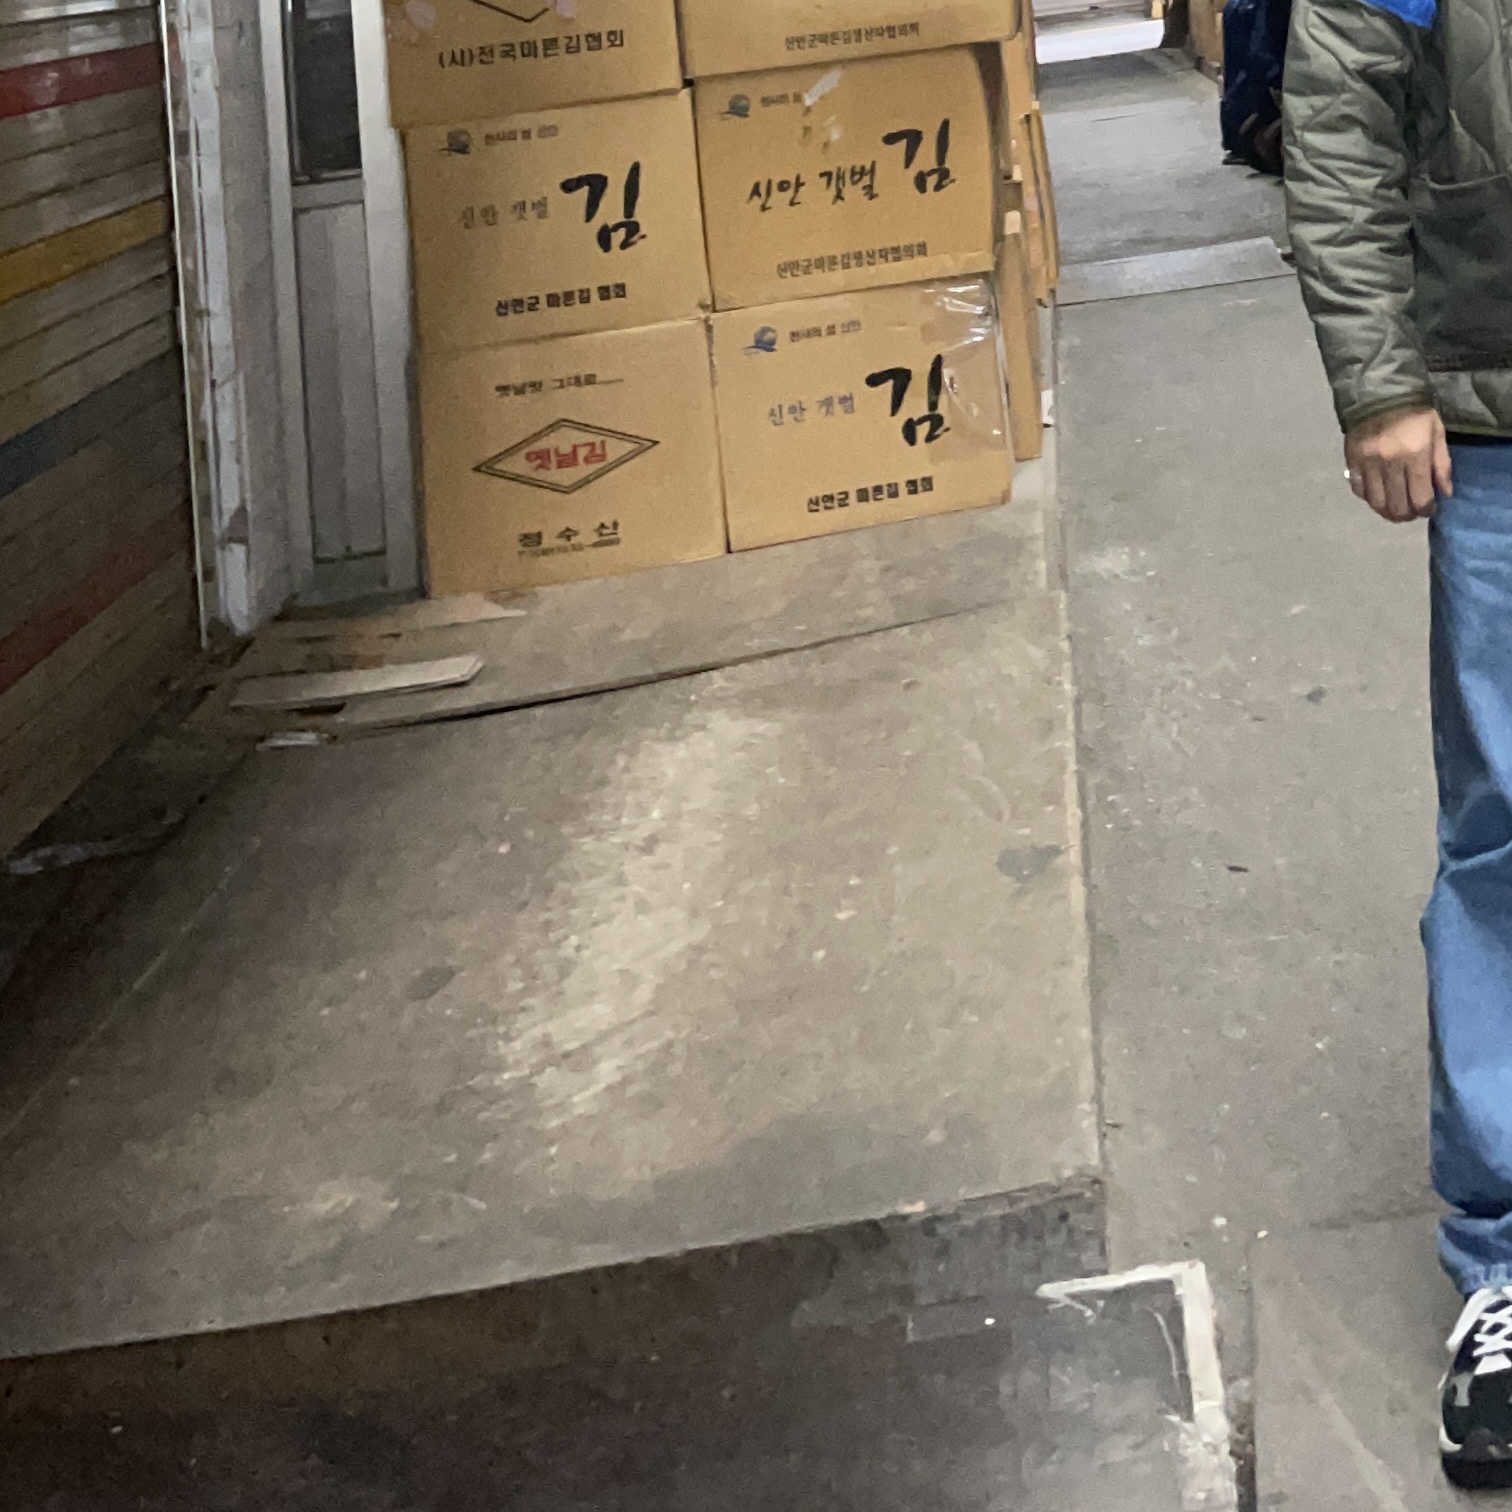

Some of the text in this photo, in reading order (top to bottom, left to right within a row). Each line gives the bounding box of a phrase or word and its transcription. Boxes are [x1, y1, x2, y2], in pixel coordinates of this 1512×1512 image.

[459, 160, 647, 254] 신안 갯벌 김
[747, 117, 956, 213] 신안 갯벌 김
[495, 294, 542, 318] 신안군
[768, 353, 951, 447] 신안 갯벌 김
[806, 490, 850, 513] 신안군
